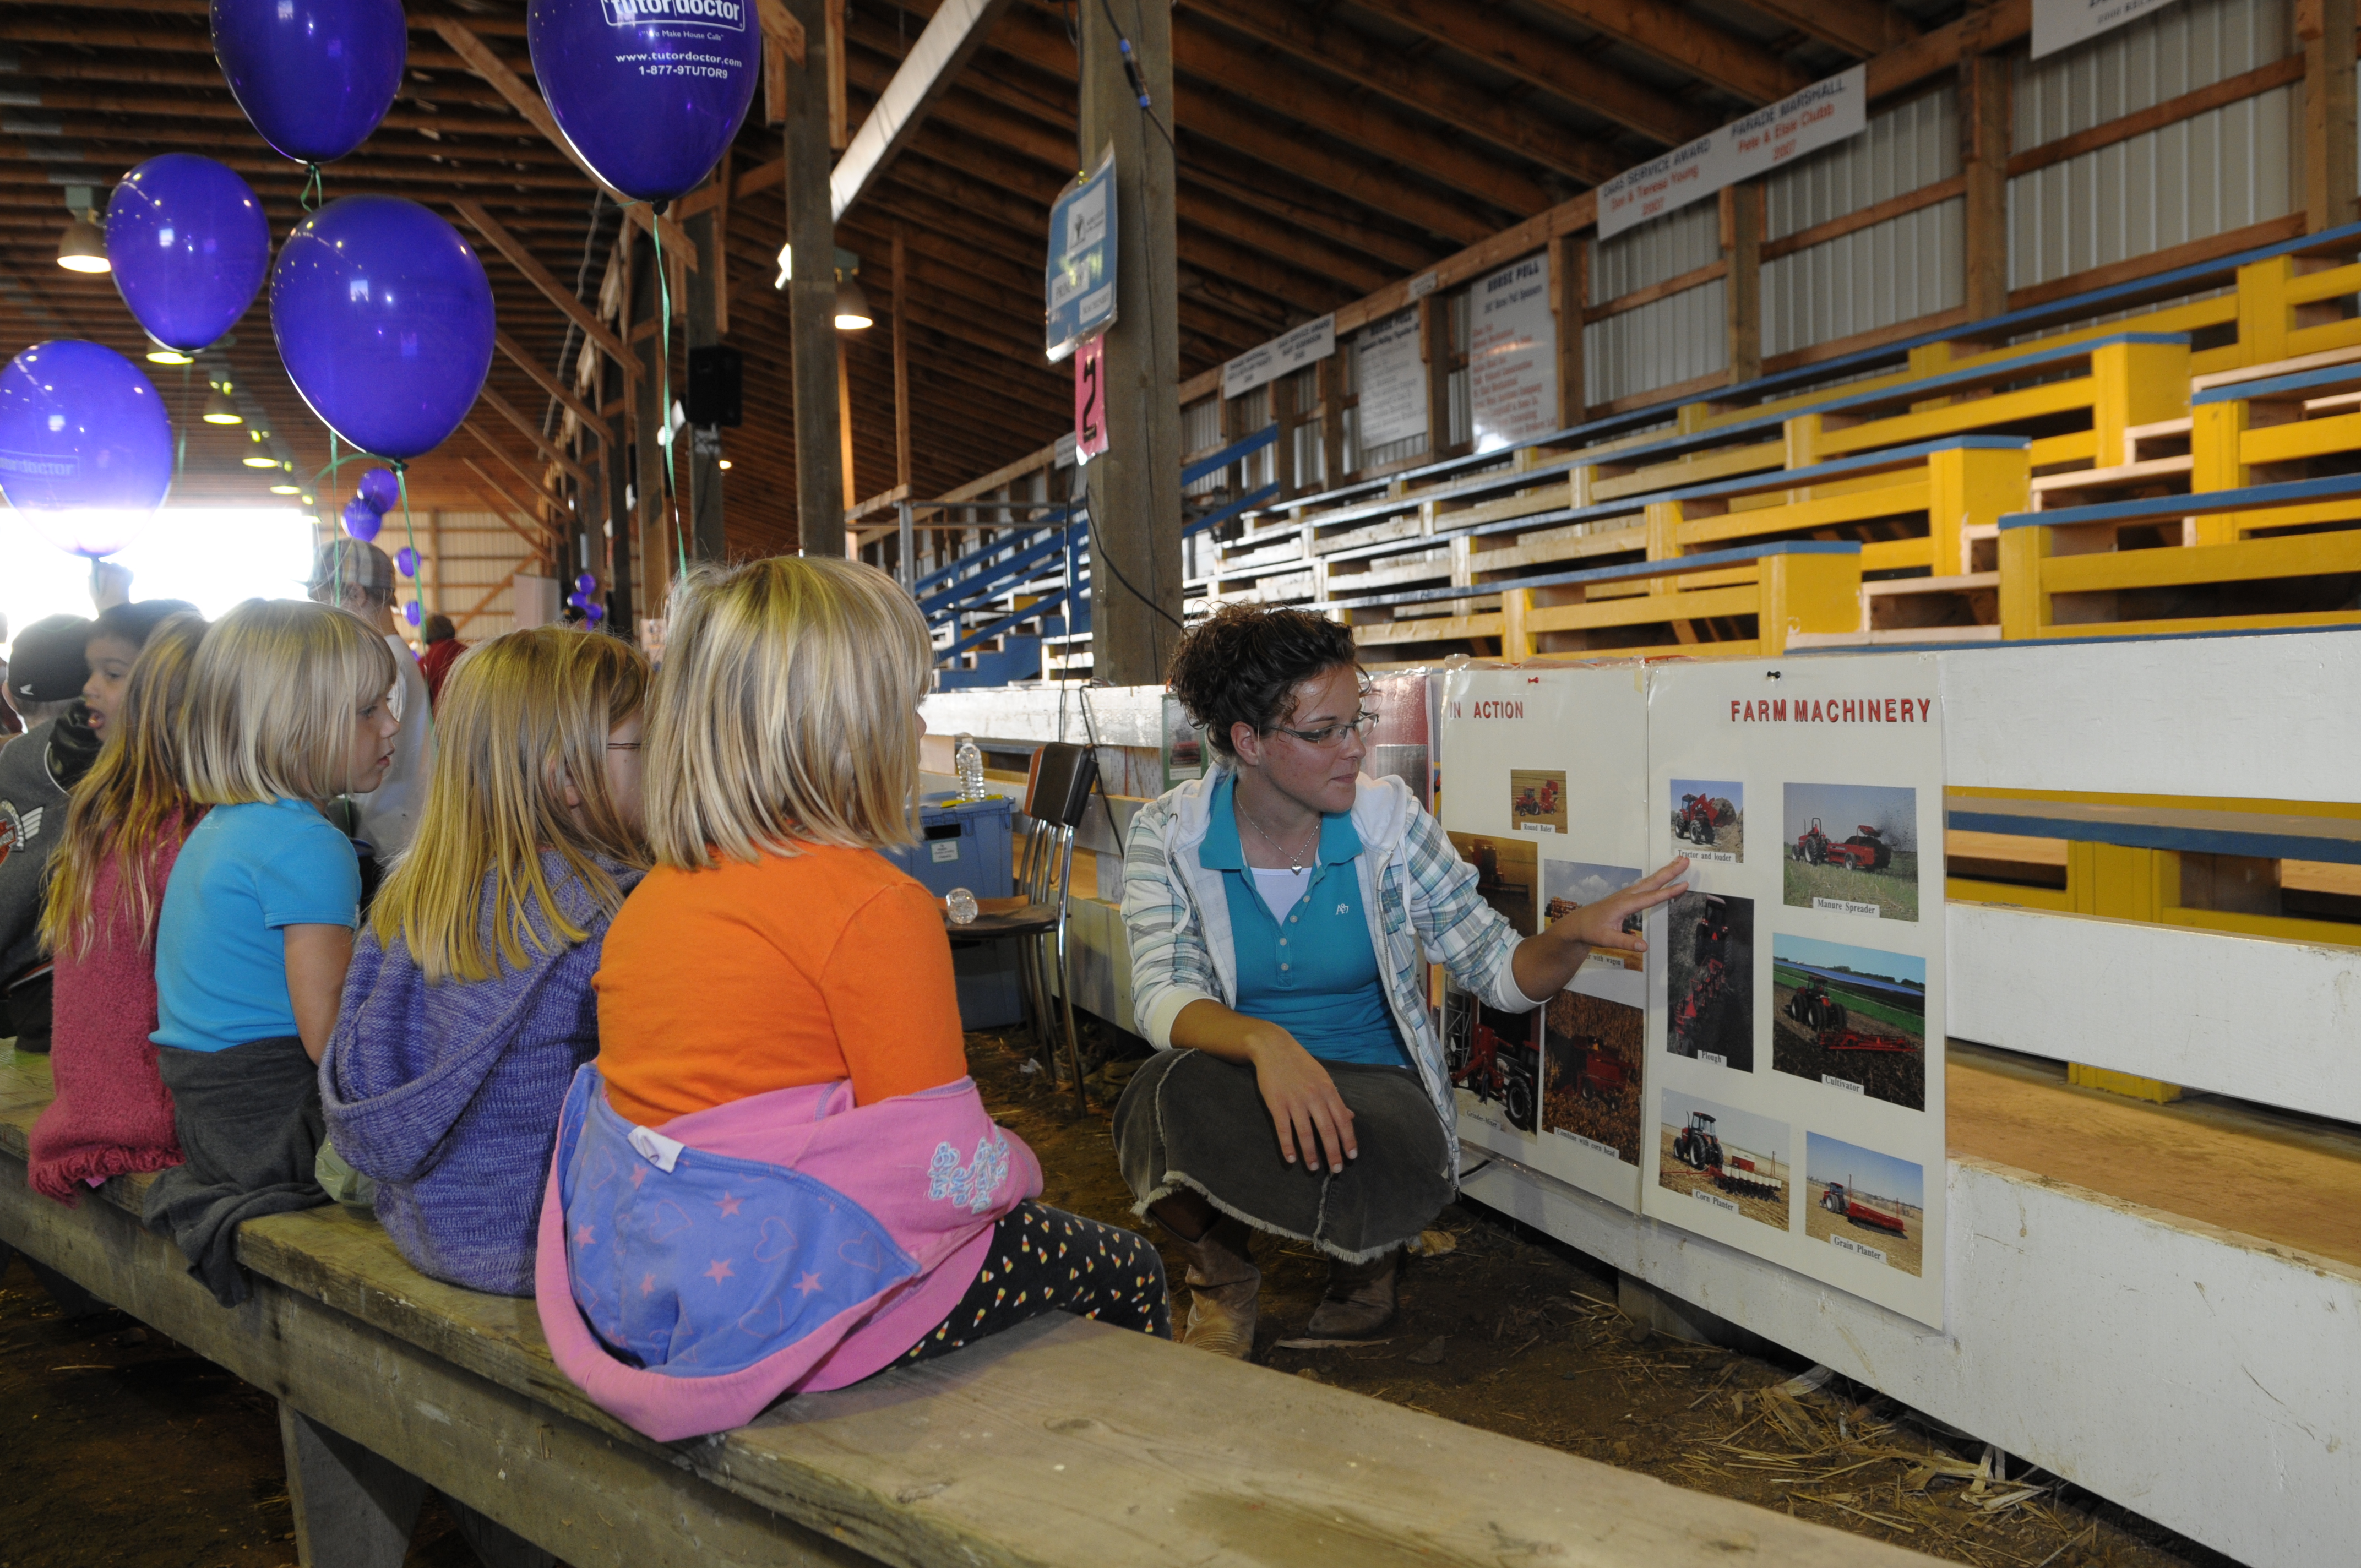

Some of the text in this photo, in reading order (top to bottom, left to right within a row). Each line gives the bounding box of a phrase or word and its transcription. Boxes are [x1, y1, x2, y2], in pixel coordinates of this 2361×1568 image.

[683, 31, 705, 39] House
[615, 51, 742, 67] www.tutordoctor.com
[638, 65, 728, 79] 1-877-9TUTOR9
[1083, 356, 1096, 443] 2
[1449, 700, 1524, 720] IN ACTION
[1731, 698, 1932, 723] FARM MACHINERY
[1539, 825, 1552, 833] Baler
[1713, 853, 1732, 862] loader
[1817, 899, 1875, 915] Manure Spreader
[1606, 957, 1621, 966] wagon
[1701, 1051, 1722, 1064] Plough
[1825, 1075, 1860, 1093] Cultivator
[1557, 1128, 1615, 1157] Combine with corn head
[1695, 1191, 1734, 1211] Corn Planter
[1834, 1237, 1881, 1260] Grain Planter
